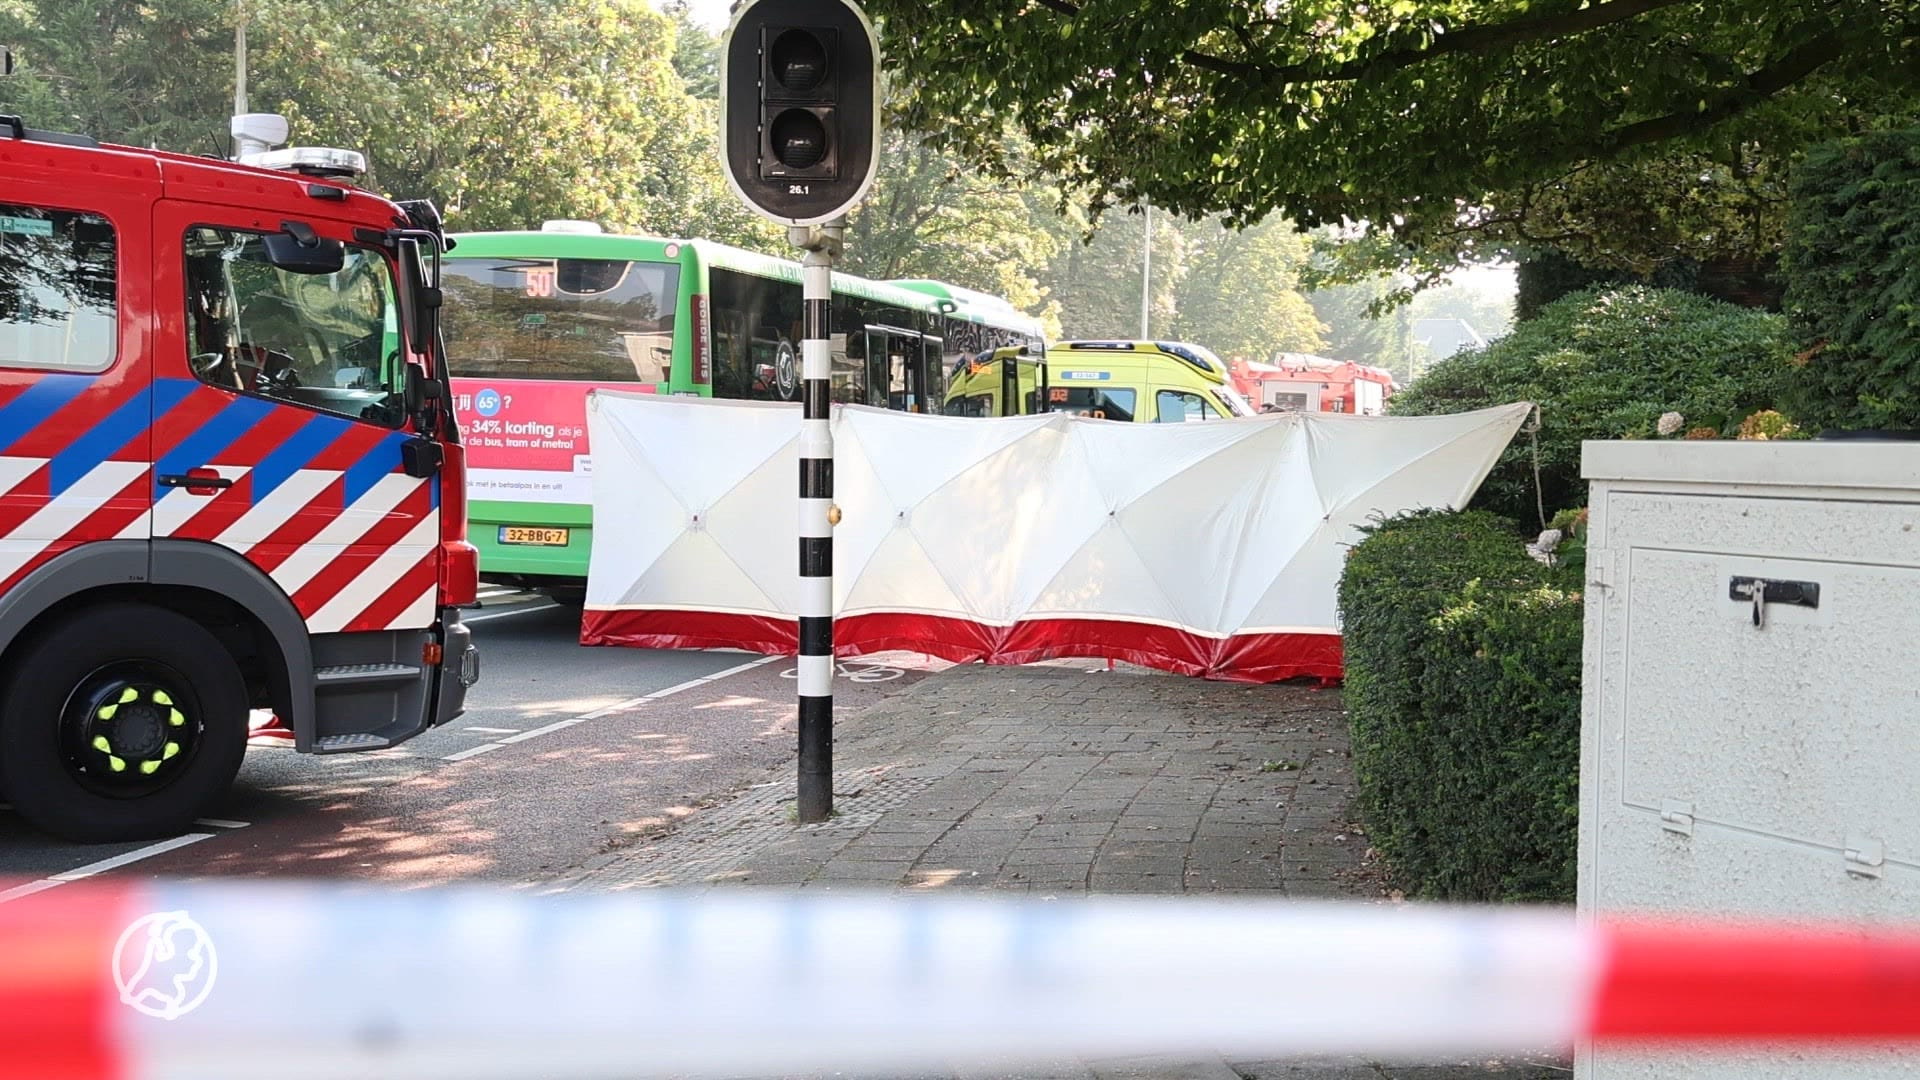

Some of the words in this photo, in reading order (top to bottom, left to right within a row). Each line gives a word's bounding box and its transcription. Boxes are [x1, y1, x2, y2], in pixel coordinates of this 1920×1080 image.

[789, 185, 809, 195] 26.1
[458, 394, 471, 411] jij
[478, 396, 498, 409] 65+
[472, 420, 502, 434] 34%
[505, 420, 555, 438] korting
[558, 426, 572, 437] als
[573, 426, 583, 438] je
[469, 437, 482, 446] de
[484, 437, 503, 448] bus,
[506, 438, 529, 448] tram
[530, 438, 540, 448] of
[542, 438, 574, 449] metro!
[490, 481, 497, 489] je
[498, 481, 532, 491] betaalpas
[508, 528, 564, 543] 32-BBG-7
